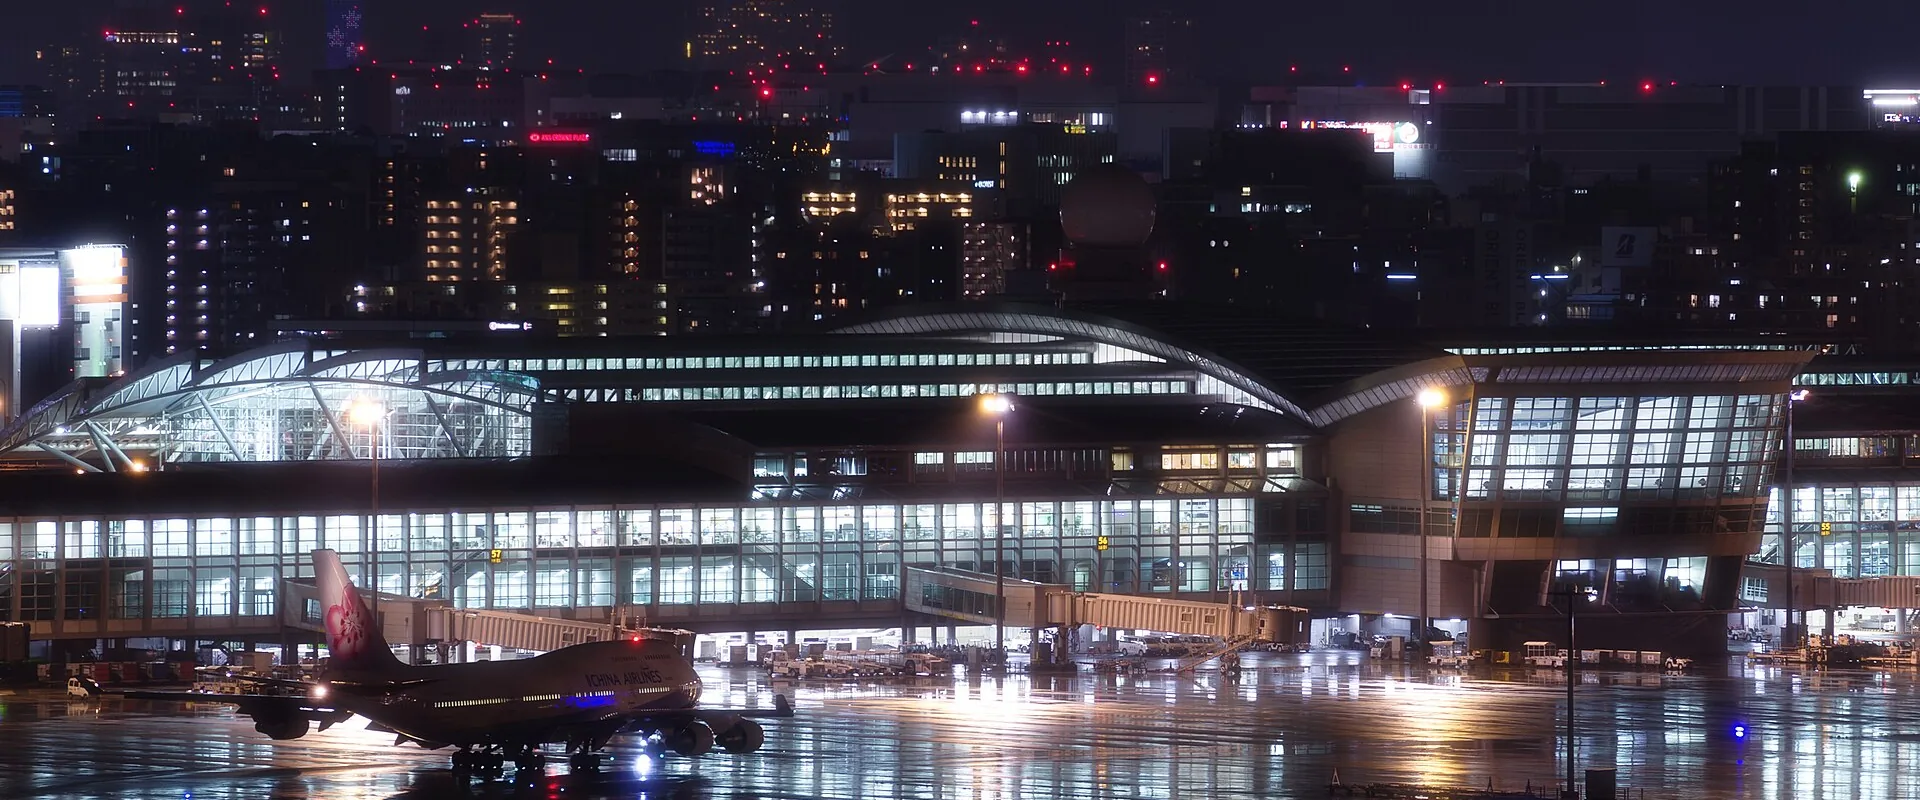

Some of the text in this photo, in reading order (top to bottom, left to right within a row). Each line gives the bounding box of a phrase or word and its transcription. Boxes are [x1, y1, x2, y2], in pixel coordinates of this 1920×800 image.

[1516, 229, 1527, 293] ORIENT
[1821, 522, 1831, 531] 55
[1098, 536, 1108, 545] 56
[491, 549, 502, 558] 57
[591, 670, 662, 687] CHINA AIRLINES
